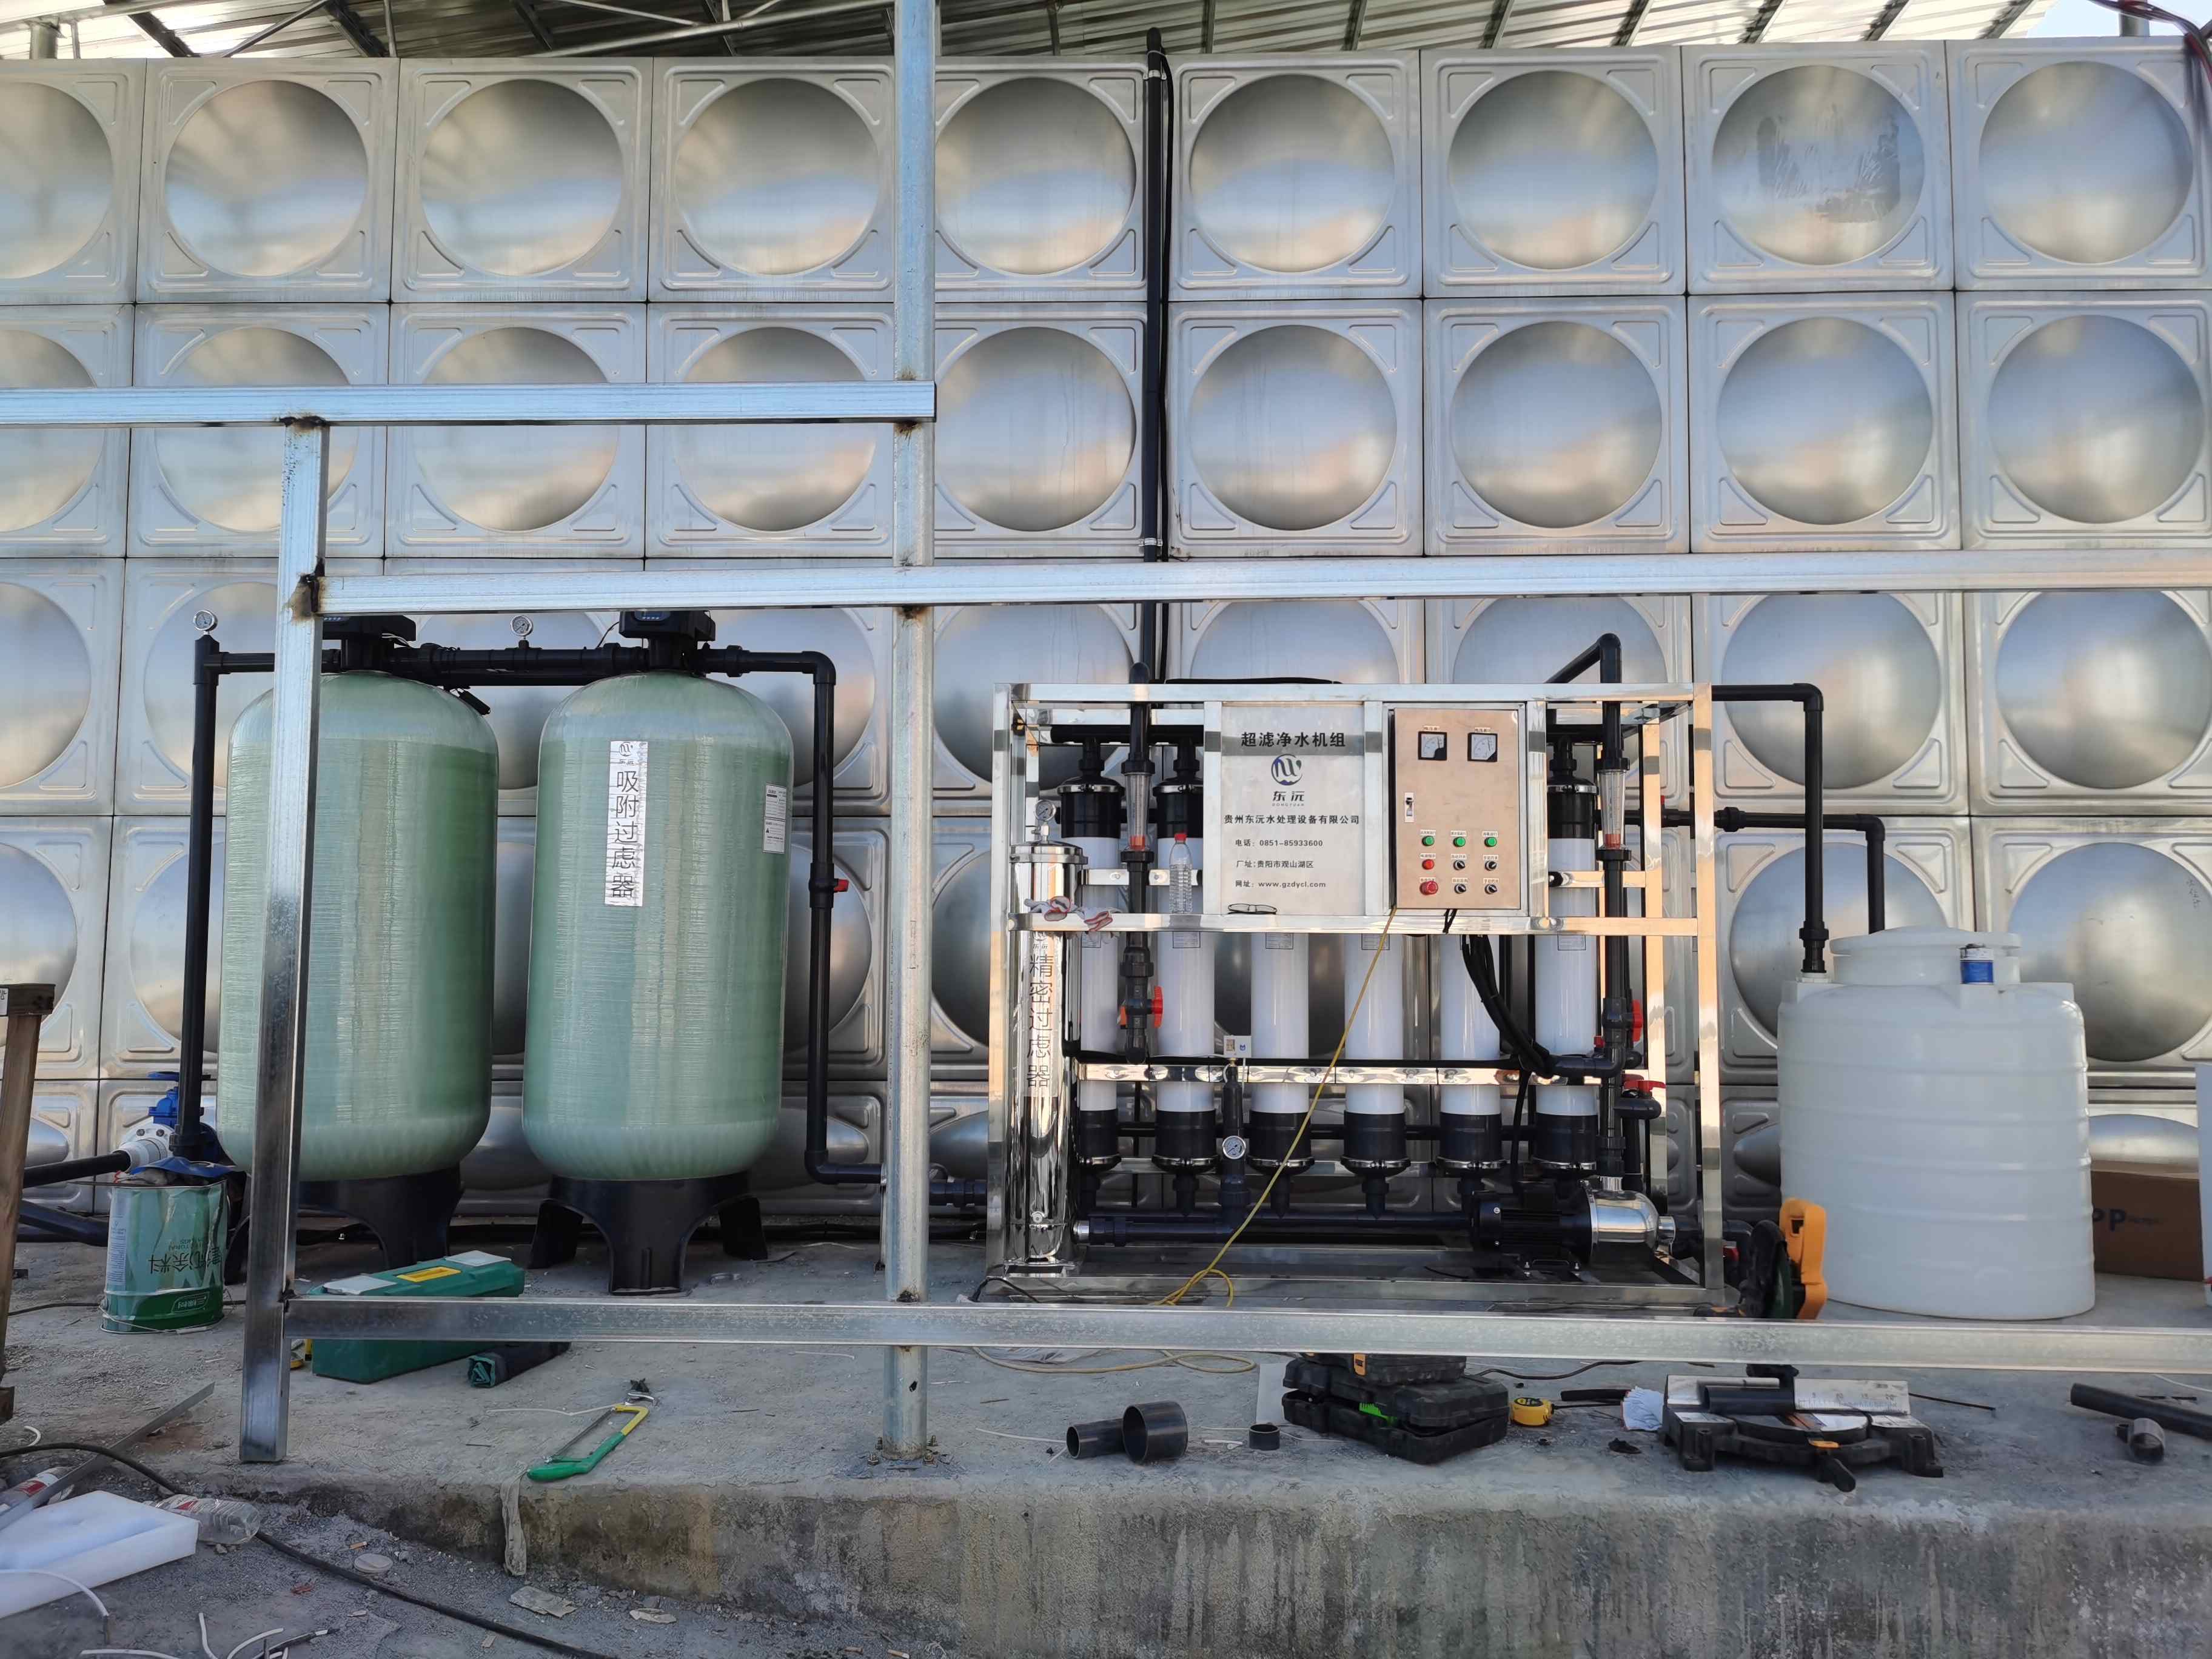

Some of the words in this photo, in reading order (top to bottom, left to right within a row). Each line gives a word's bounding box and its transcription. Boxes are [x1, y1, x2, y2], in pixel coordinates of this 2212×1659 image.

[1241, 731, 1346, 748] 超滤净水机组
[1224, 815, 1359, 825] 贵州东沅水处理设备有限公司
